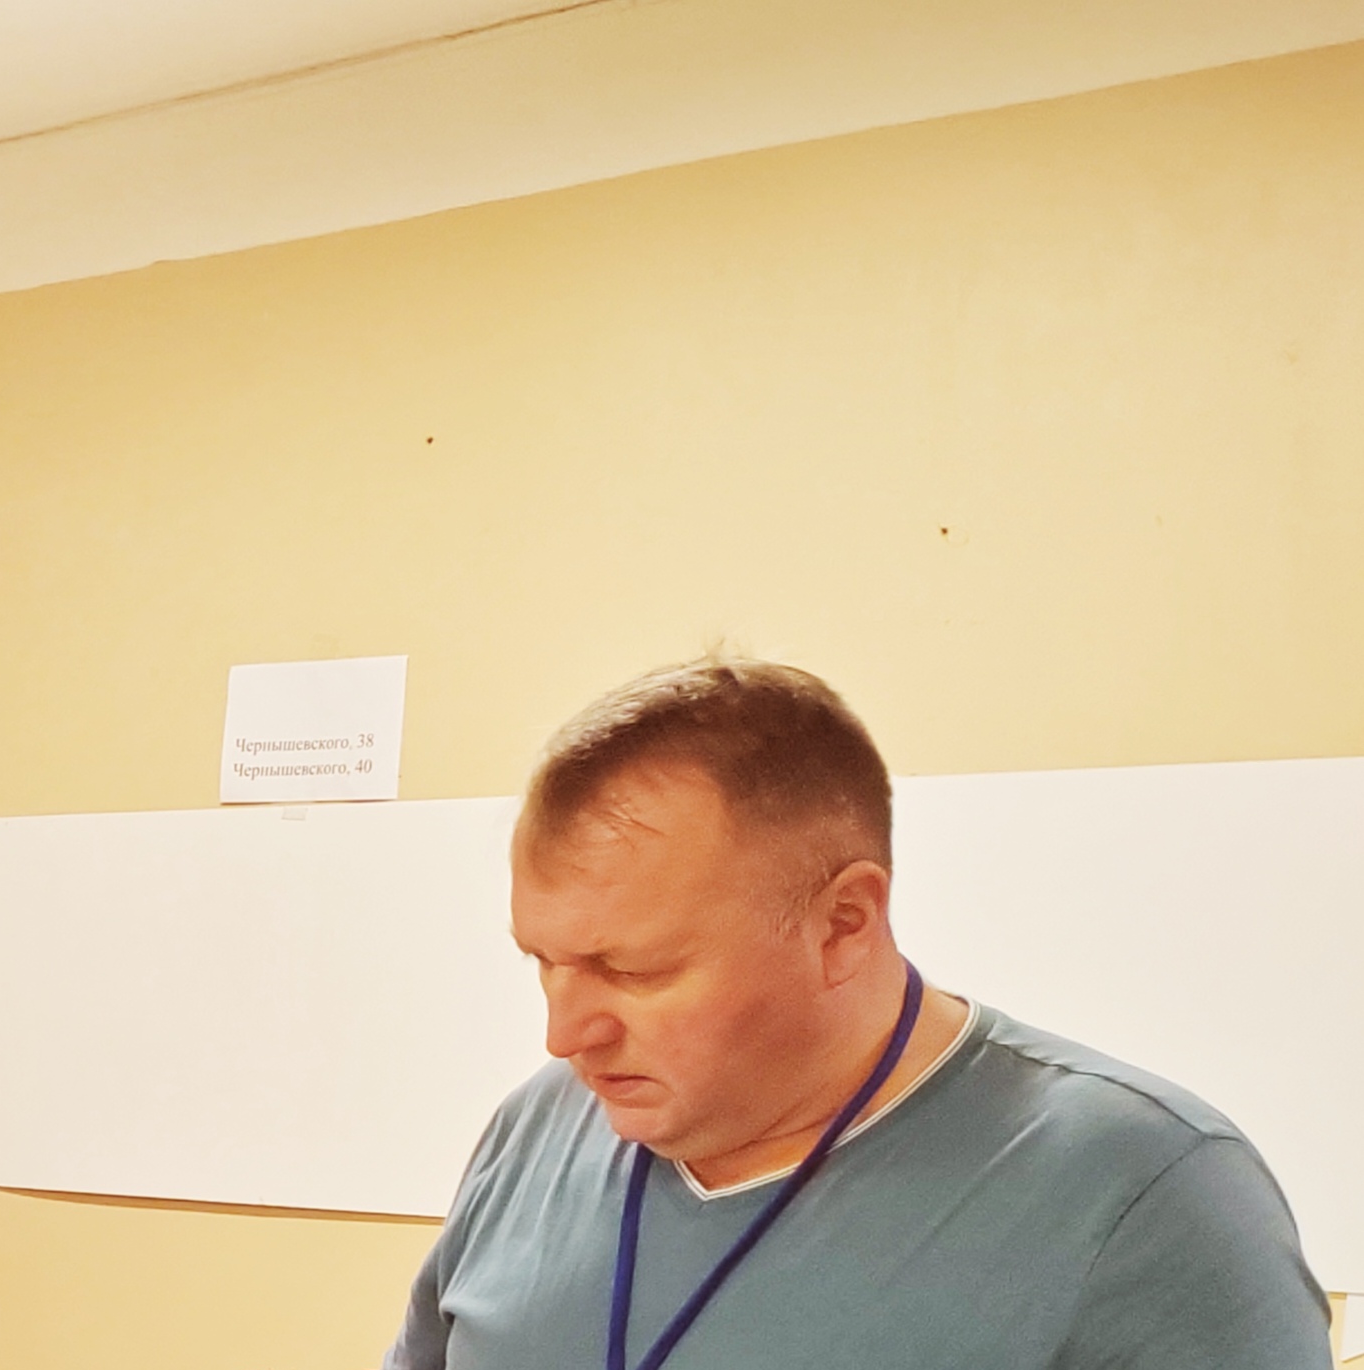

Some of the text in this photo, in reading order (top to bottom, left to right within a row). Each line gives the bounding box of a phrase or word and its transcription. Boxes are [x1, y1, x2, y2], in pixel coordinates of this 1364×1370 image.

[235, 733, 375, 756] Чернышевского, 38
[233, 758, 373, 781] Чернышевского, 40
